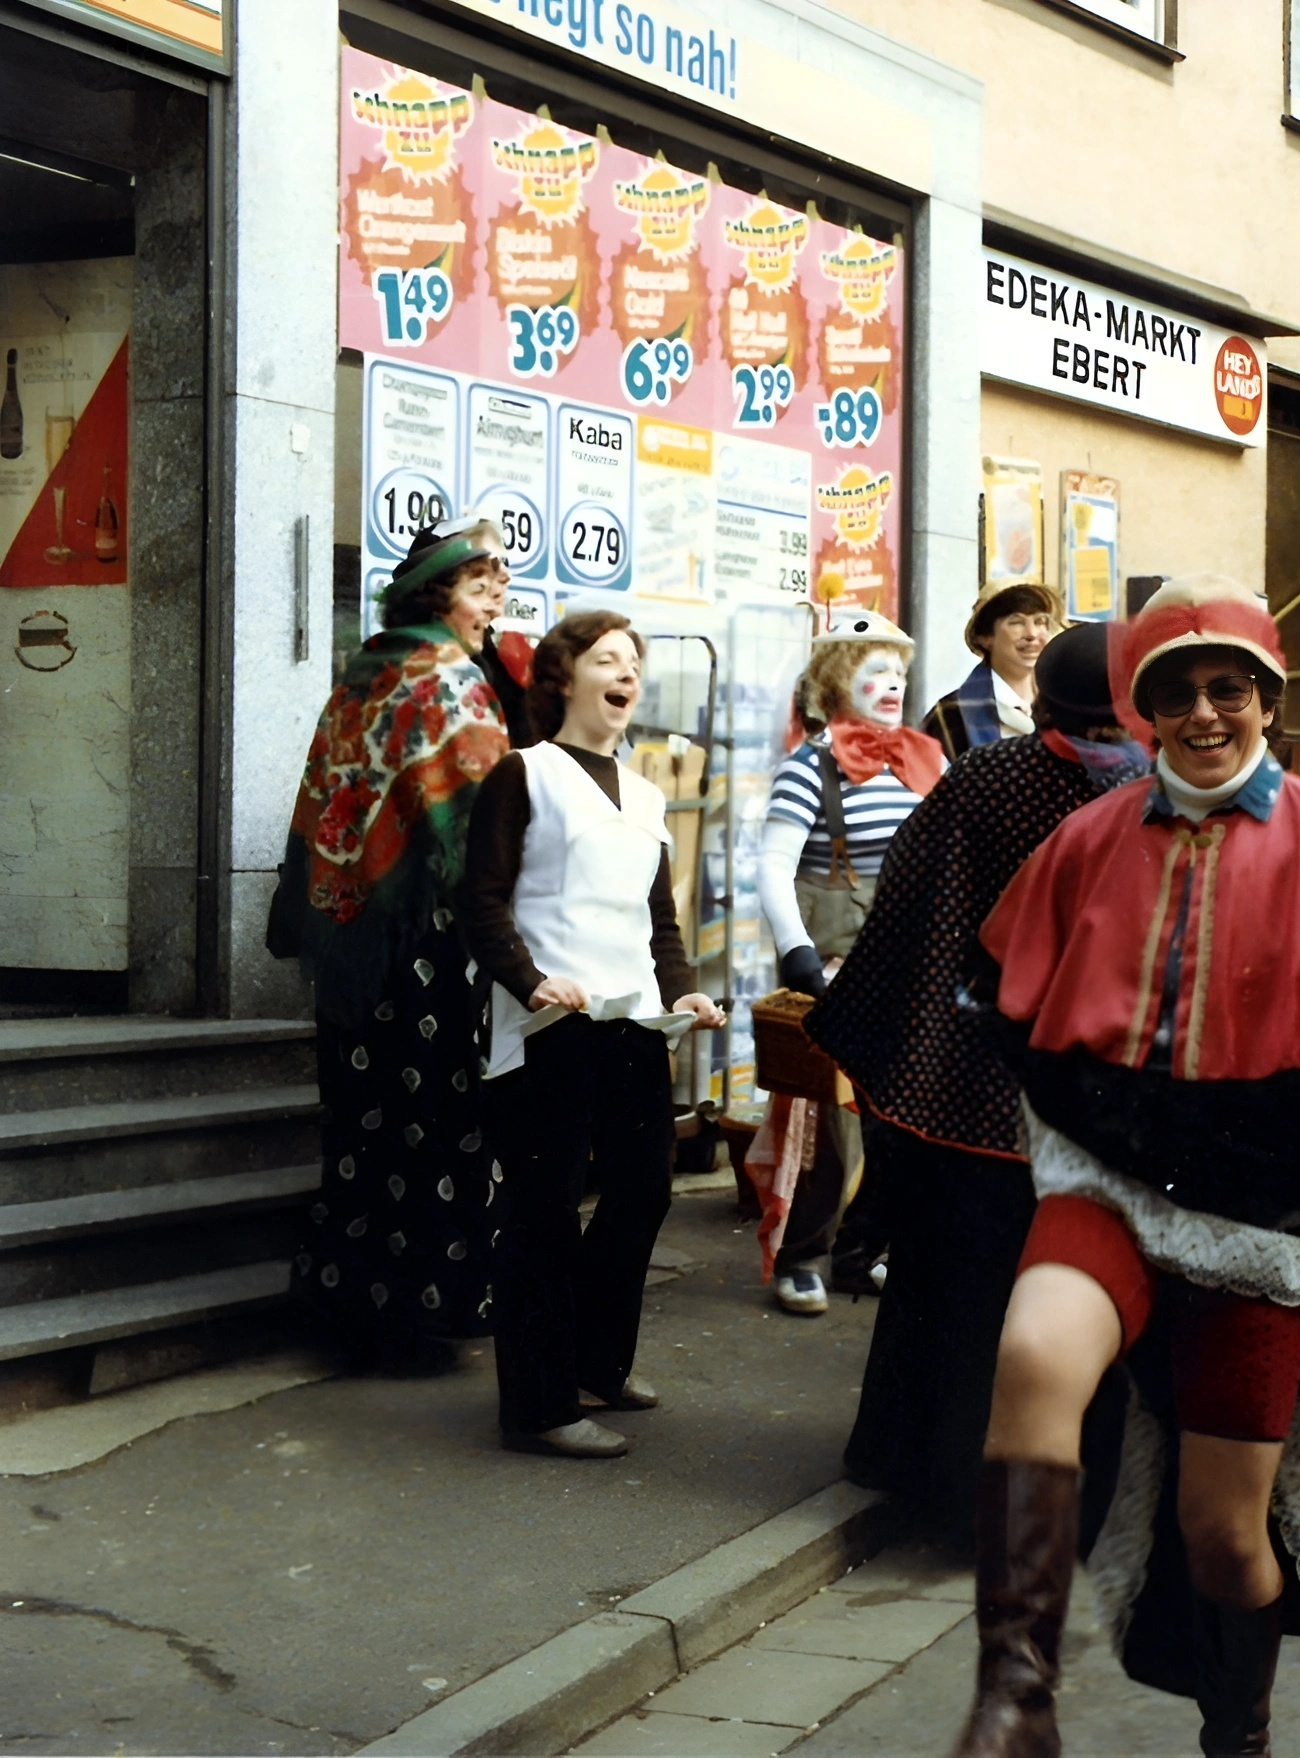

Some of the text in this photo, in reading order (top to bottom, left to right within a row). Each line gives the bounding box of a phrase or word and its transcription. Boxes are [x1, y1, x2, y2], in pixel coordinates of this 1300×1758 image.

[518, 0, 736, 100] egt so nah!
[378, 273, 449, 341] 1.49
[987, 260, 1202, 364] EDEKA-MARKT
[510, 310, 575, 372] 3.69
[1052, 338, 1147, 400] EBERT
[1224, 349, 1252, 376] HEY
[625, 342, 690, 401] 6.99
[735, 368, 792, 423] 2.99
[569, 417, 623, 450] Kaba
[572, 521, 620, 566] 2.79
